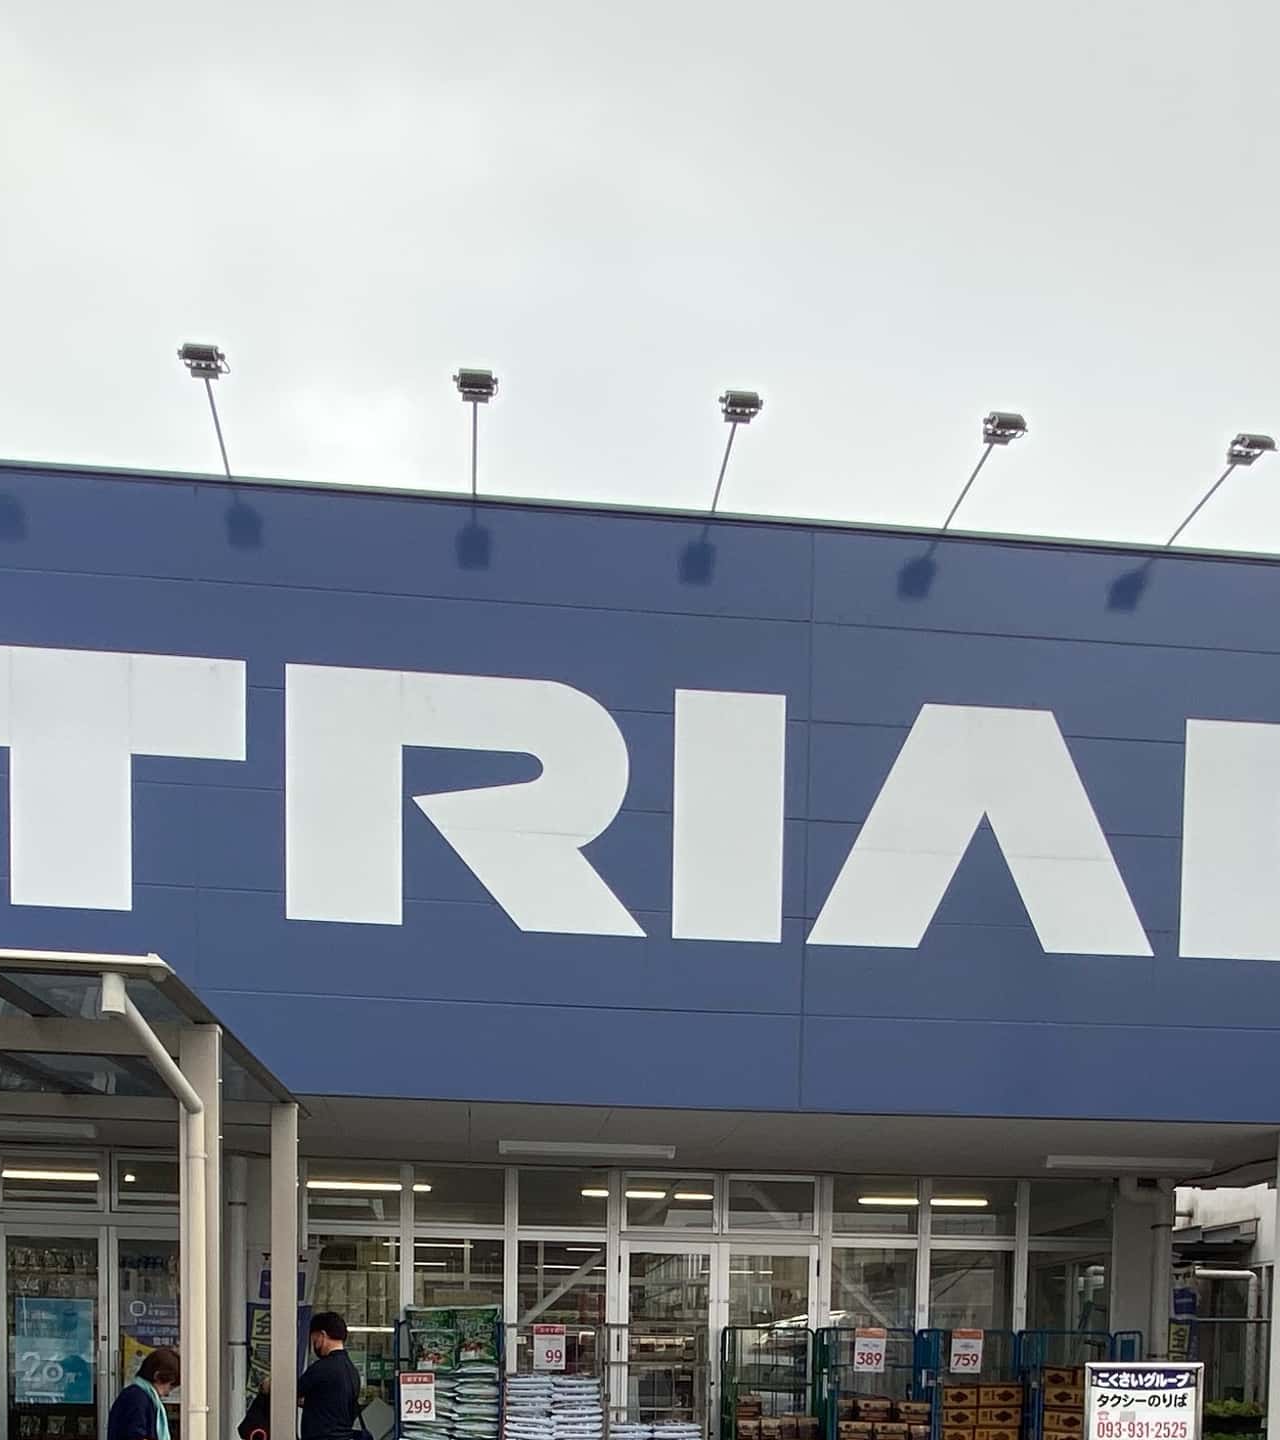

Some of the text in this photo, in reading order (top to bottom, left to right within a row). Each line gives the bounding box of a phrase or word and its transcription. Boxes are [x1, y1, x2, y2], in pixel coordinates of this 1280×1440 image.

[856, 1352, 883, 1366] 389
[953, 1353, 979, 1367] 759
[1098, 1372, 1190, 1388] こくさいグループ
[404, 1399, 432, 1414] 299
[1096, 1393, 1188, 1408] タクシーのりば
[1096, 1421, 1188, 1439] 093-931-2525
